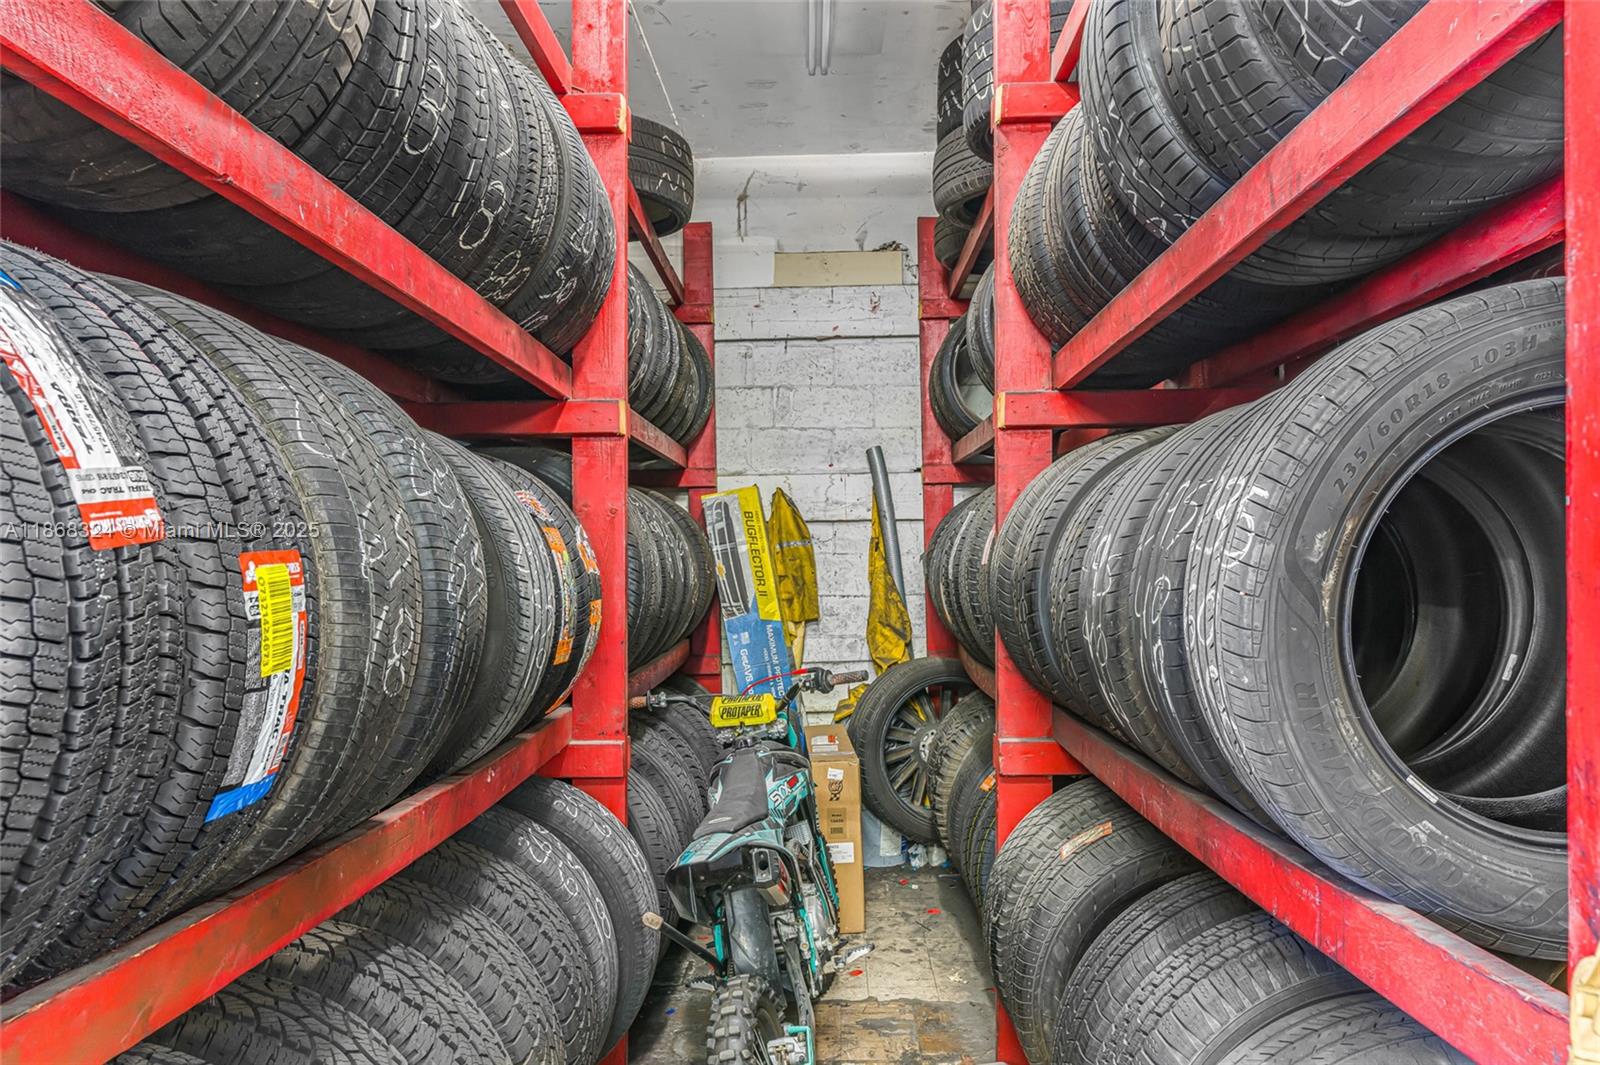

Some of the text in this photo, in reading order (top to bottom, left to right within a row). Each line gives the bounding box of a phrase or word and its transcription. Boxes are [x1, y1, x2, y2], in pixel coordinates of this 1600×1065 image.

[1333, 334, 1539, 494] 235/60R18 103H
[744, 511, 766, 586] BUGFLECTOR
[766, 624, 779, 665] MAXIMUM
[721, 704, 762, 719] PROTAPER
